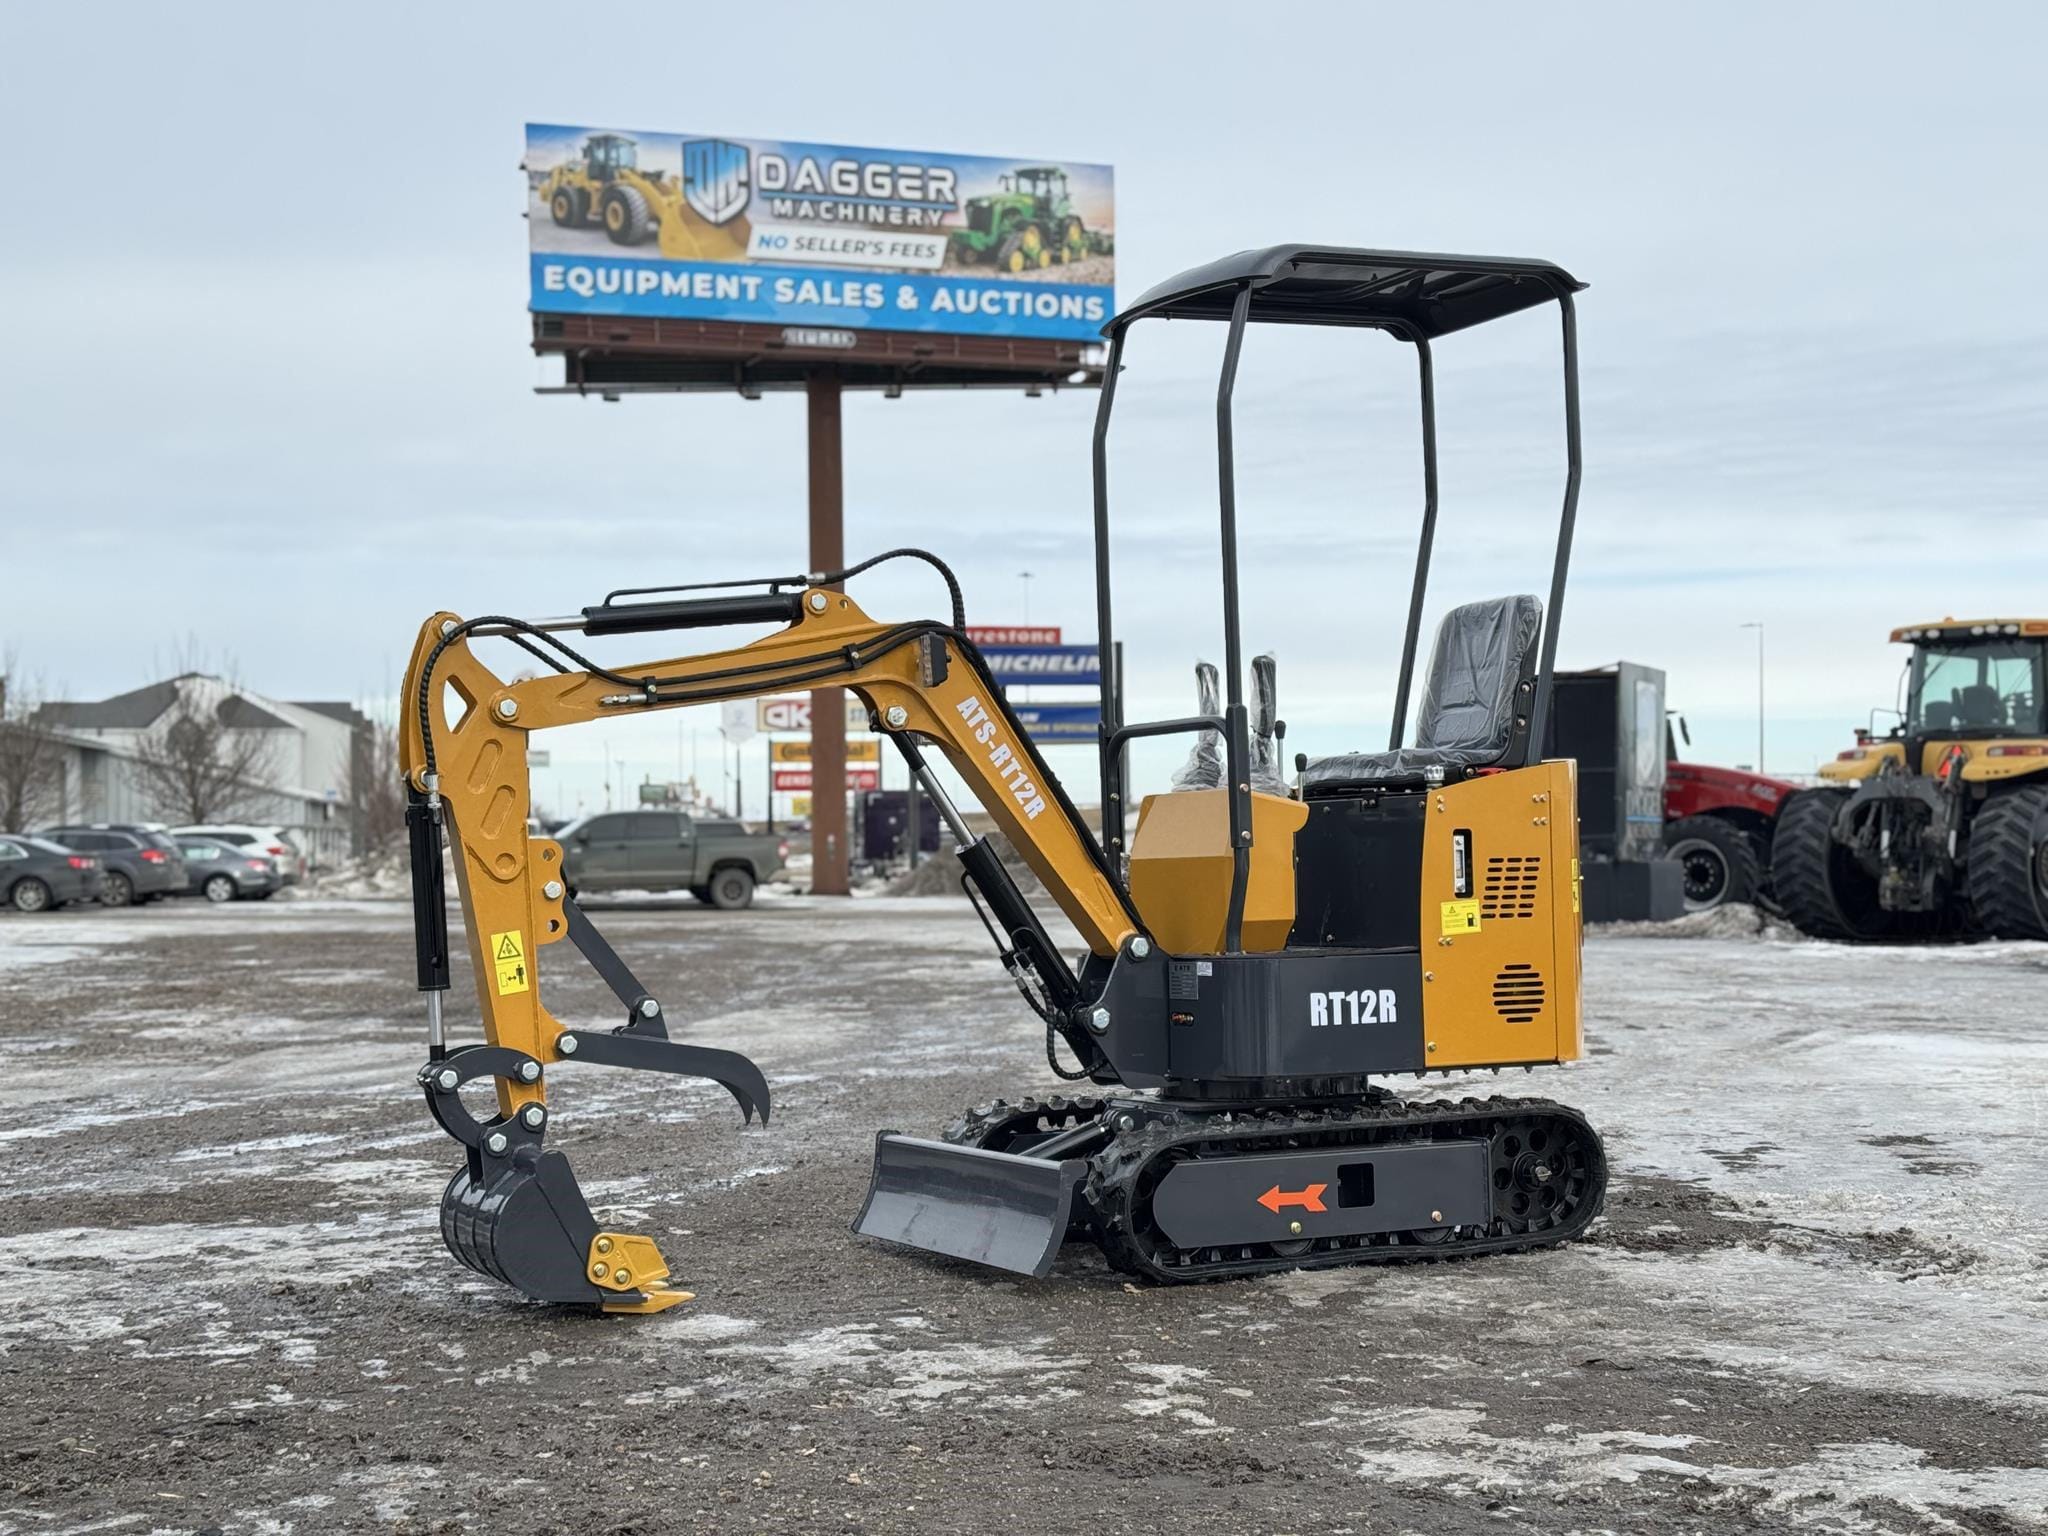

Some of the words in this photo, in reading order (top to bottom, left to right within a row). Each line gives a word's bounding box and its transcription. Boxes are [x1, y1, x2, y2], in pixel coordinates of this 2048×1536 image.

[758, 155, 956, 202] DAGGER
[773, 199, 944, 226] MACHINERY
[758, 235, 788, 249] NO
[794, 236, 885, 256] SELLER'S
[889, 242, 936, 258] FEES
[544, 265, 762, 300] EQUIPMENT
[774, 278, 884, 308] SALES
[896, 285, 919, 310] &
[931, 287, 1104, 321] AUCTIONS
[956, 696, 1045, 820] ATS-RT12R
[1310, 989, 1397, 1026] RT12R
